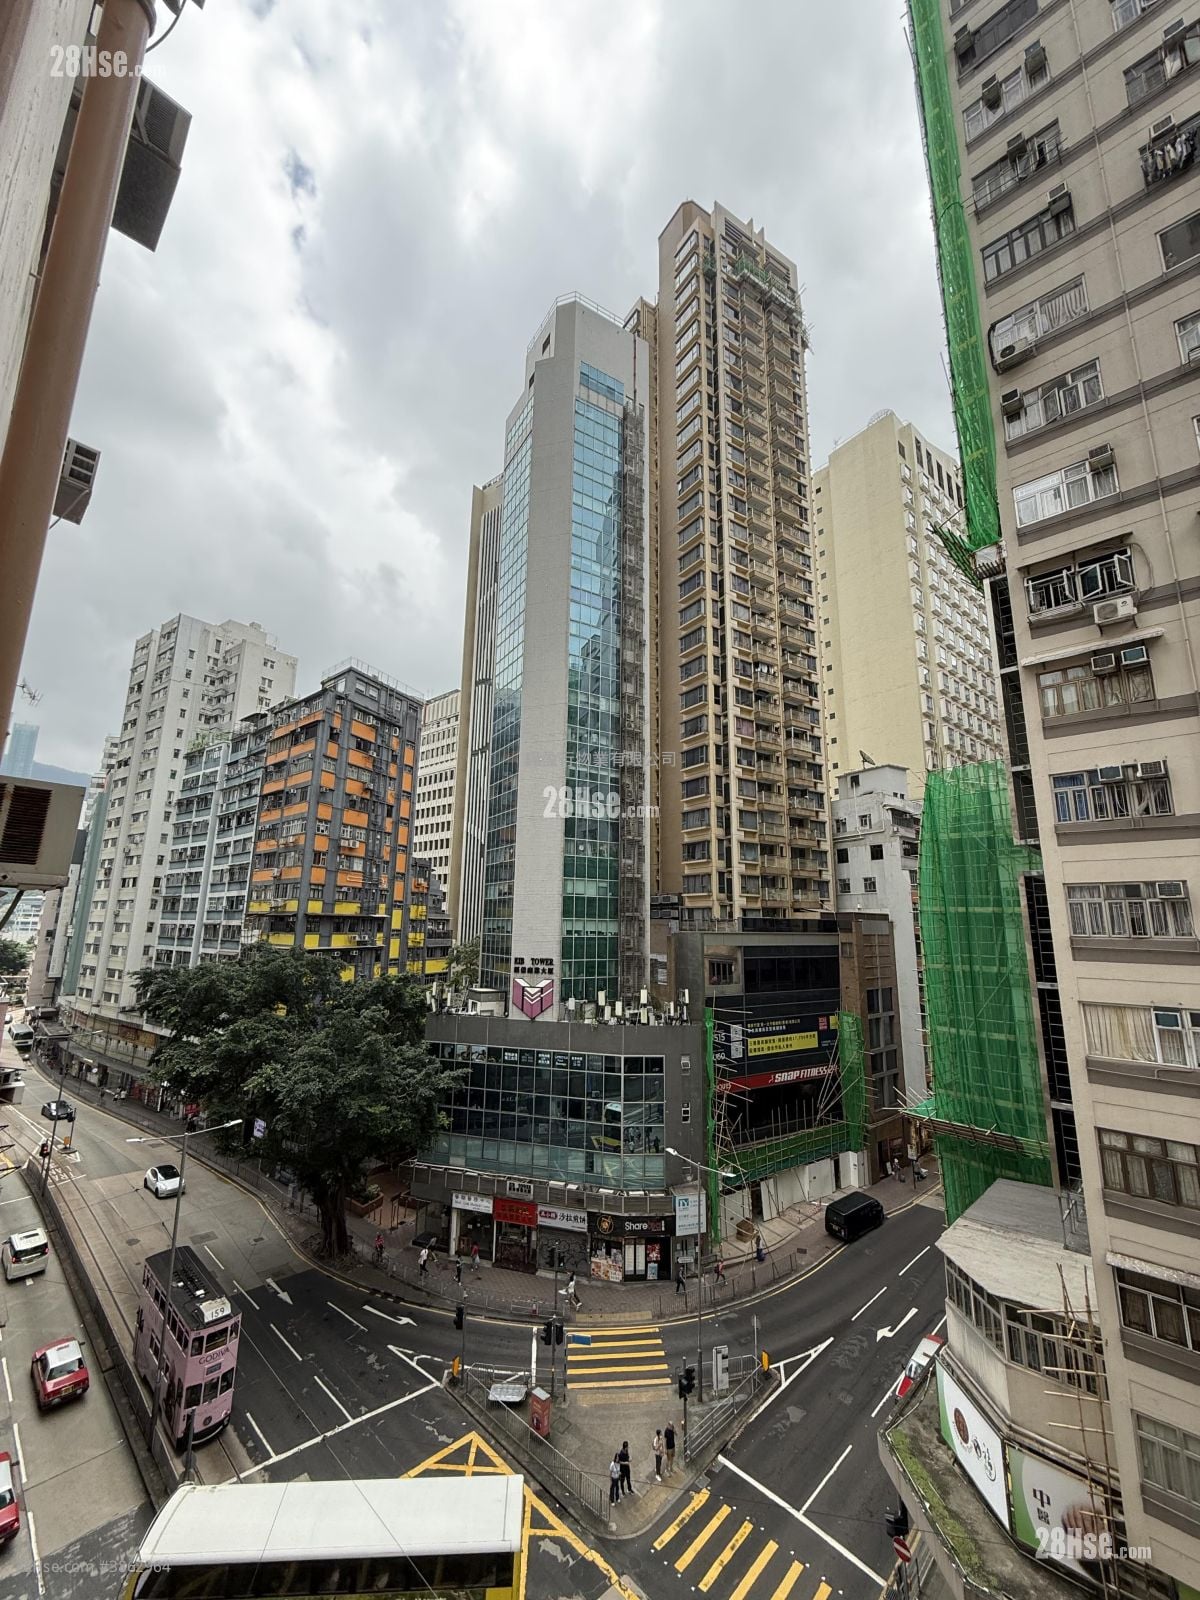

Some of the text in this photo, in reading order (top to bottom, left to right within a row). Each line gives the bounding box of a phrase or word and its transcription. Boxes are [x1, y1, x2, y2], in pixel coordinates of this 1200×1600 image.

[530, 958, 554, 966] TOWER
[800, 1065, 828, 1079] FITNESS
[211, 1307, 225, 1320] 159
[198, 1346, 230, 1365] GODIVA
